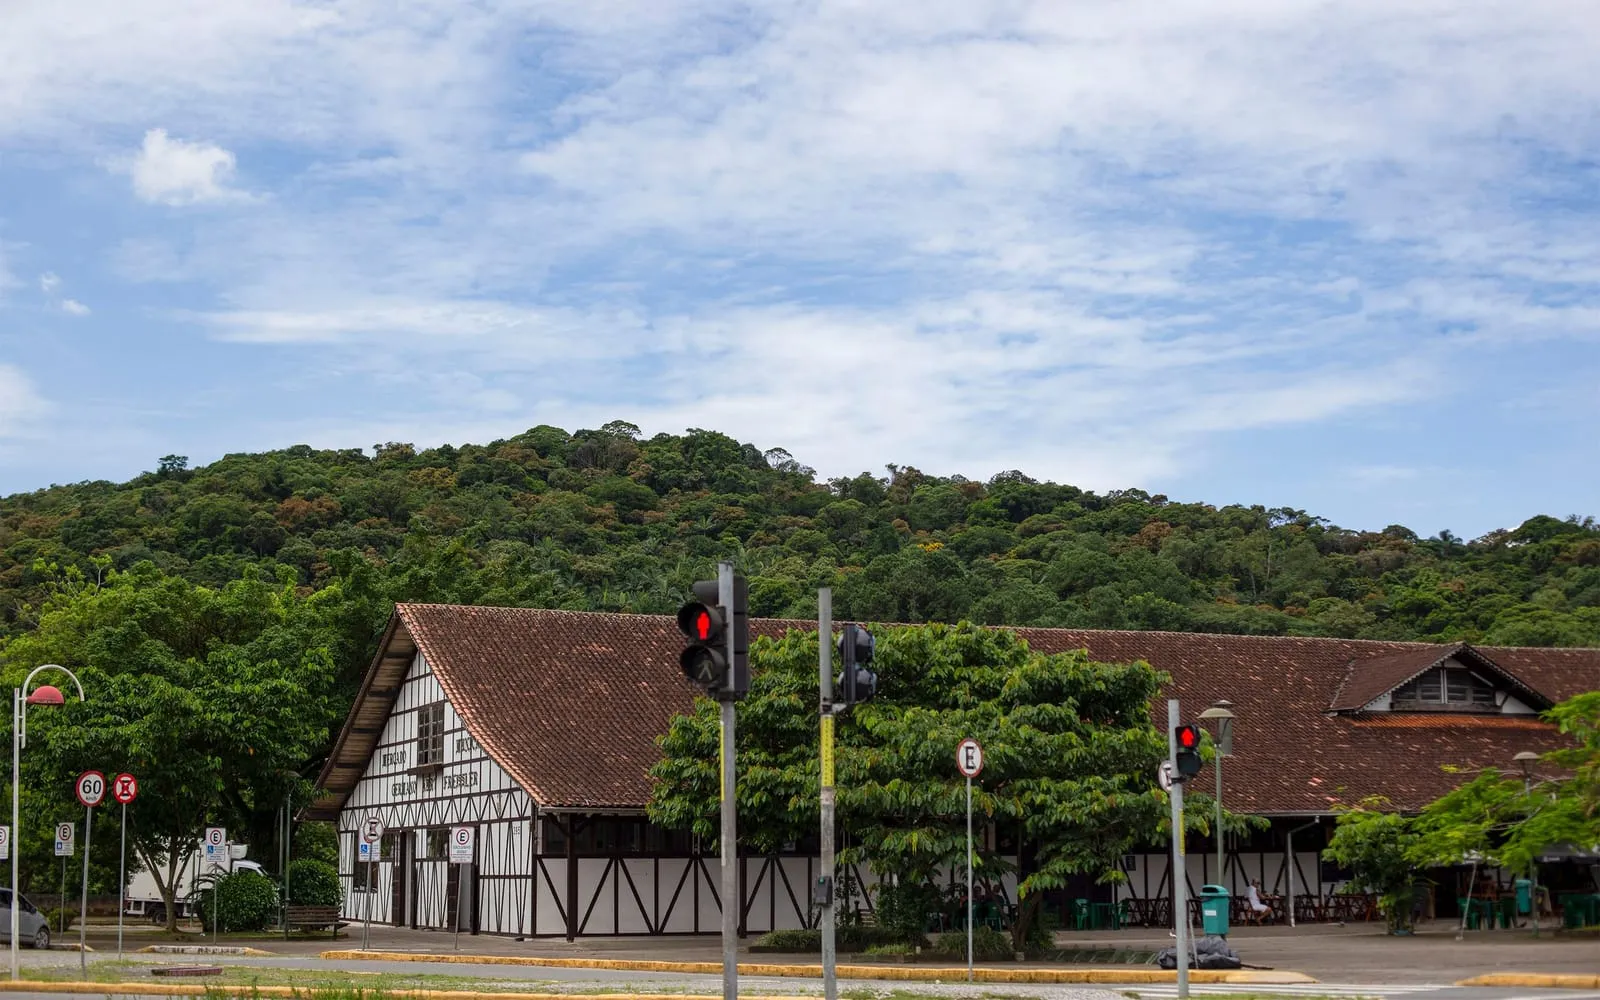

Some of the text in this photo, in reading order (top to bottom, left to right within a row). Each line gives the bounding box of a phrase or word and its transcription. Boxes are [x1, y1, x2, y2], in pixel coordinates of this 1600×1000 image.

[382, 750, 406, 768] MERCADO
[966, 746, 976, 769] E
[82, 780, 102, 794] 60
[62, 828, 68, 838] E
[213, 833, 218, 842] E
[459, 832, 466, 842] E
